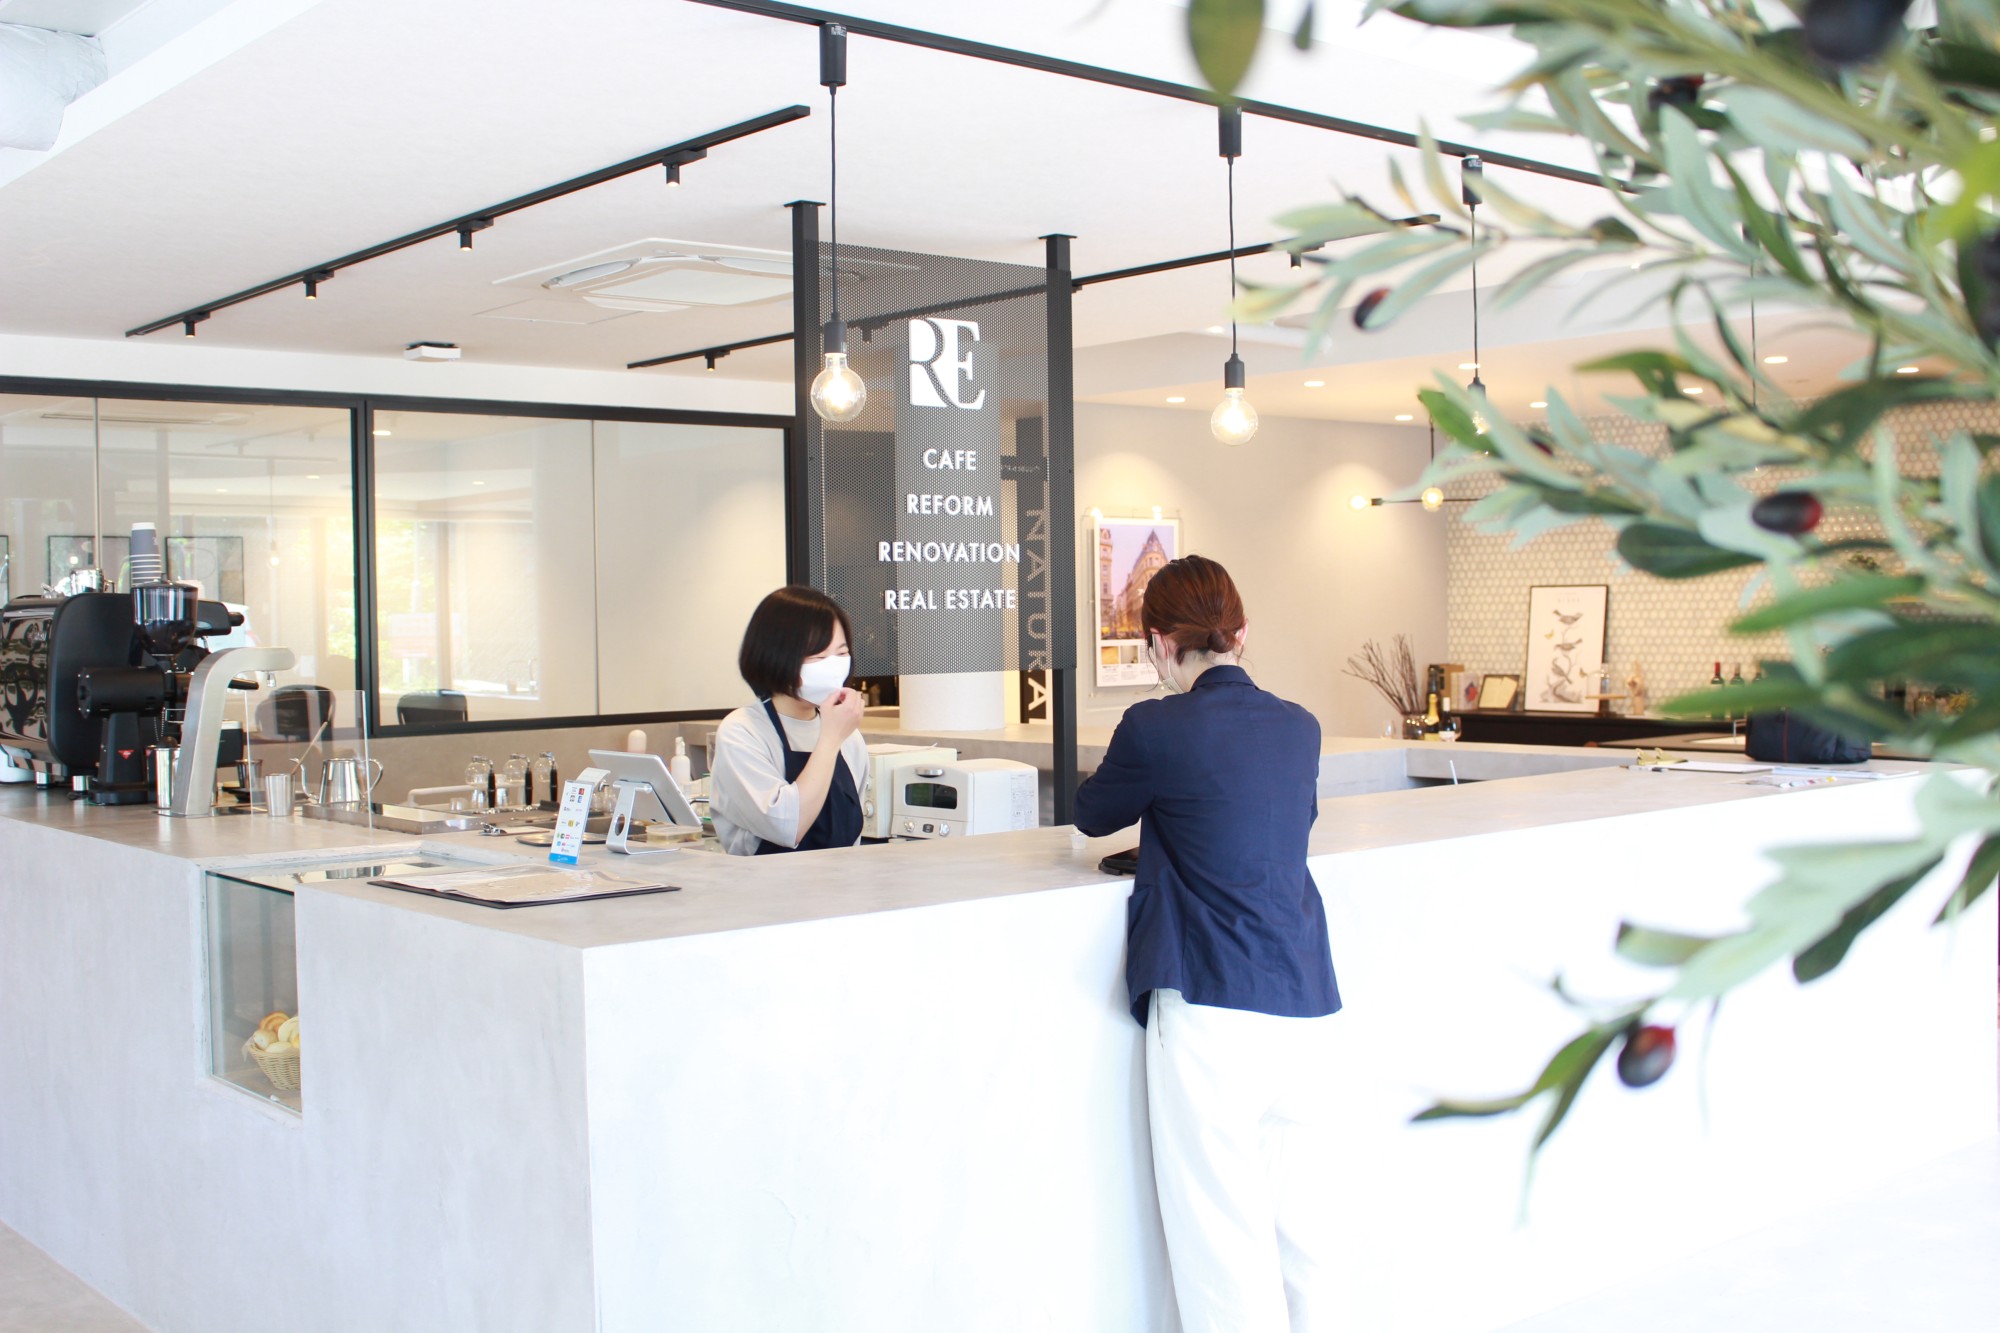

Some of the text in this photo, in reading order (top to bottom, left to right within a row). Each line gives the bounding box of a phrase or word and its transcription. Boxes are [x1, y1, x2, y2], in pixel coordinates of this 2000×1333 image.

[909, 317, 986, 410] RE
[922, 448, 977, 470] CAFE
[906, 493, 993, 516] REFORM
[878, 541, 1020, 563] RENOVATION
[884, 589, 1016, 610] REAL ESTATE
